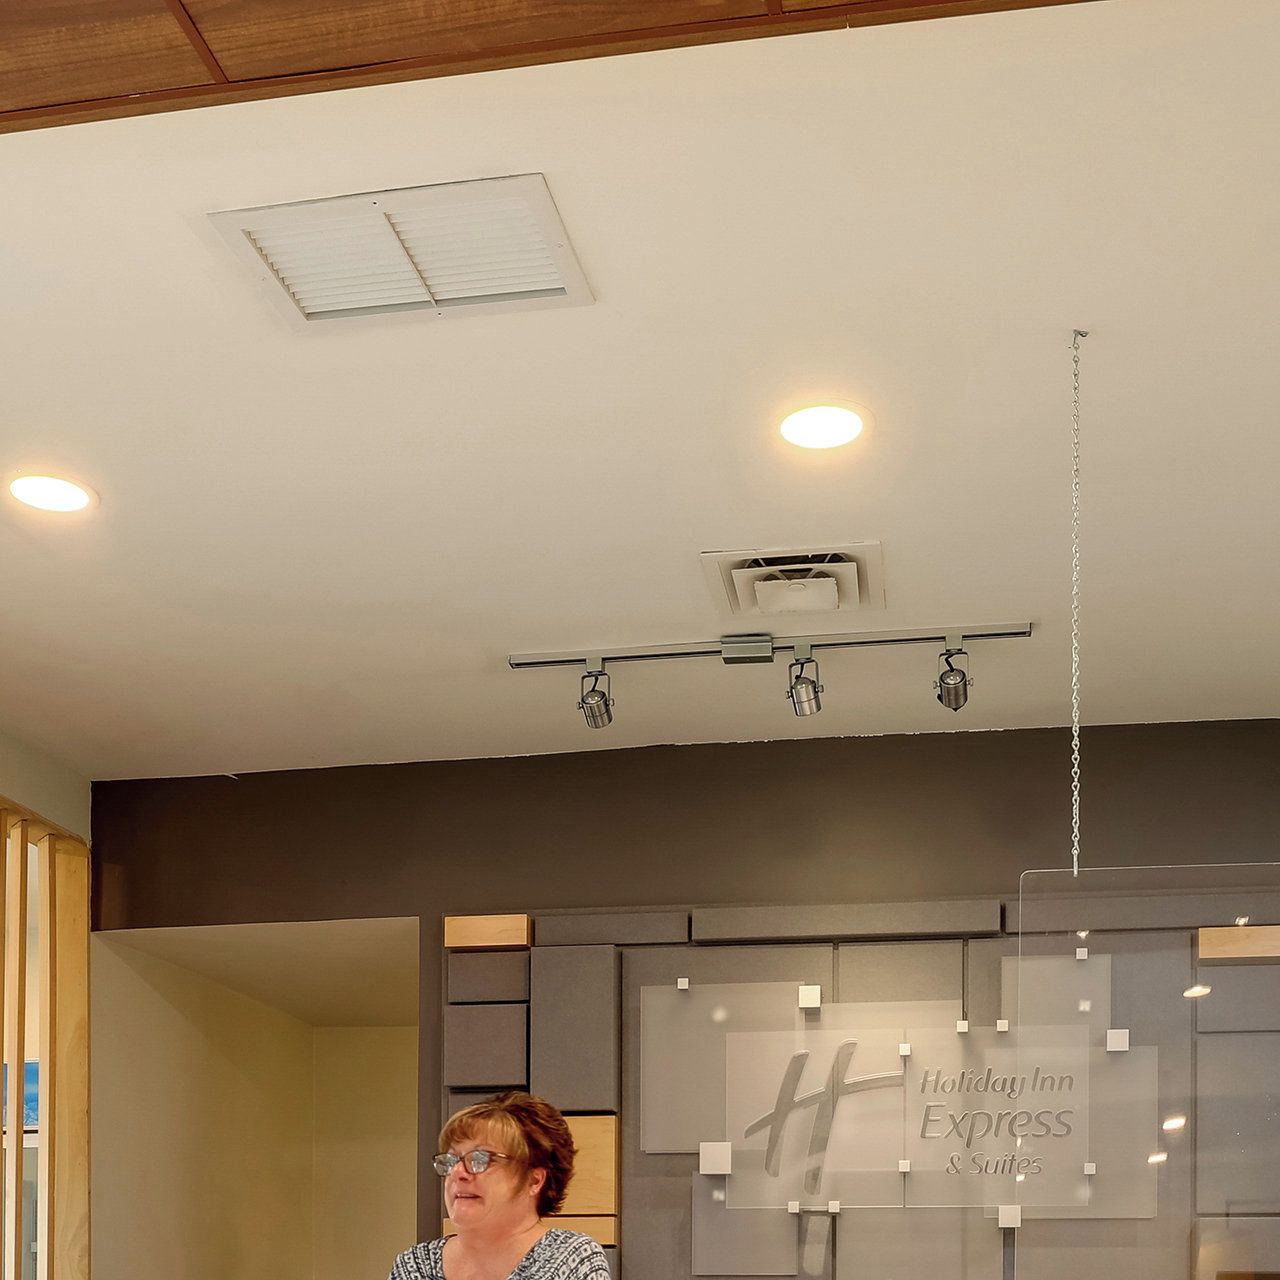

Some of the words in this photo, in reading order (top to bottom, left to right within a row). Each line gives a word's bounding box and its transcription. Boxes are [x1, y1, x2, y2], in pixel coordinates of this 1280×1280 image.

[920, 1066, 1027, 1099] Holiday
[1032, 1066, 1074, 1092] Inn
[920, 1102, 1074, 1149] Express
[946, 1152, 962, 1175] &
[969, 1152, 1043, 1175] Suites
